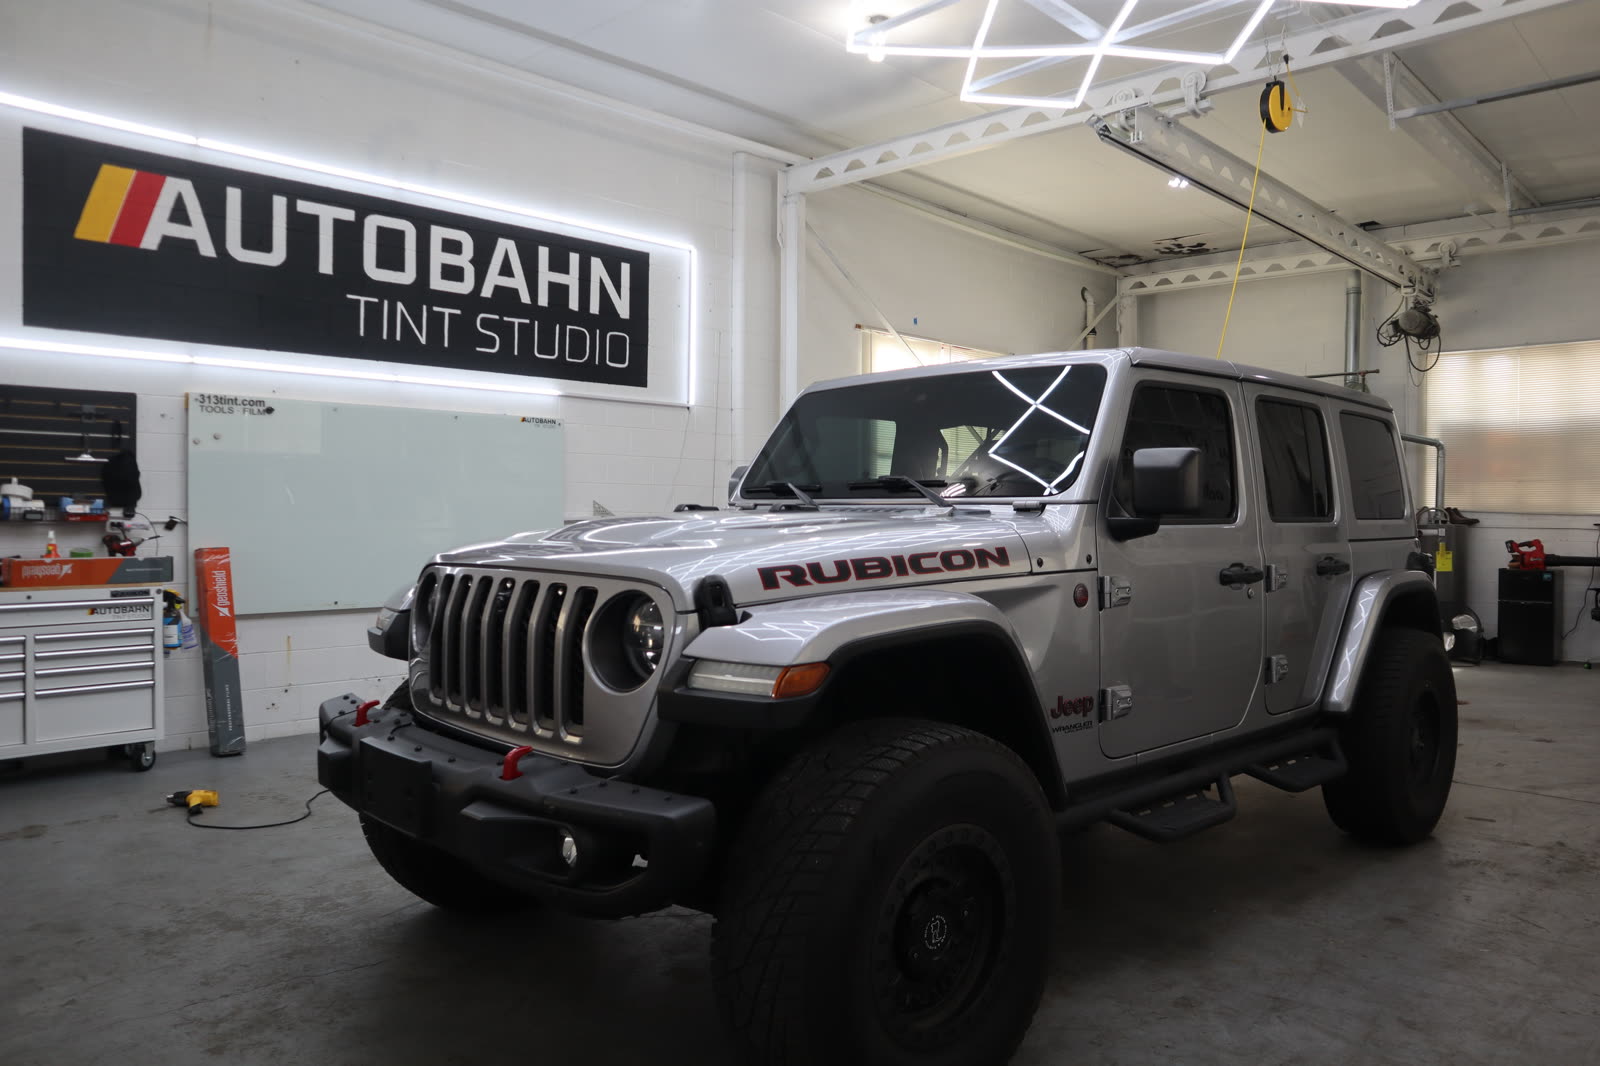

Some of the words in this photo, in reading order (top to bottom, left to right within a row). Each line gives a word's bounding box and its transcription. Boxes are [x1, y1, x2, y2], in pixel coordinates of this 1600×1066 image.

[139, 176, 631, 319] AUTOBAHN
[346, 293, 461, 348] TINT
[475, 313, 630, 369] STUDIO
[199, 393, 266, 408] 313tint.com
[199, 404, 235, 415] TOOLS
[524, 416, 557, 425] AUTOBAHN
[757, 546, 1011, 591] RUBICON
[211, 570, 231, 606] geoshield
[93, 604, 150, 616] AUTOBAHN
[1050, 695, 1095, 719] Jeep
[1052, 720, 1093, 733] WRANGLER
